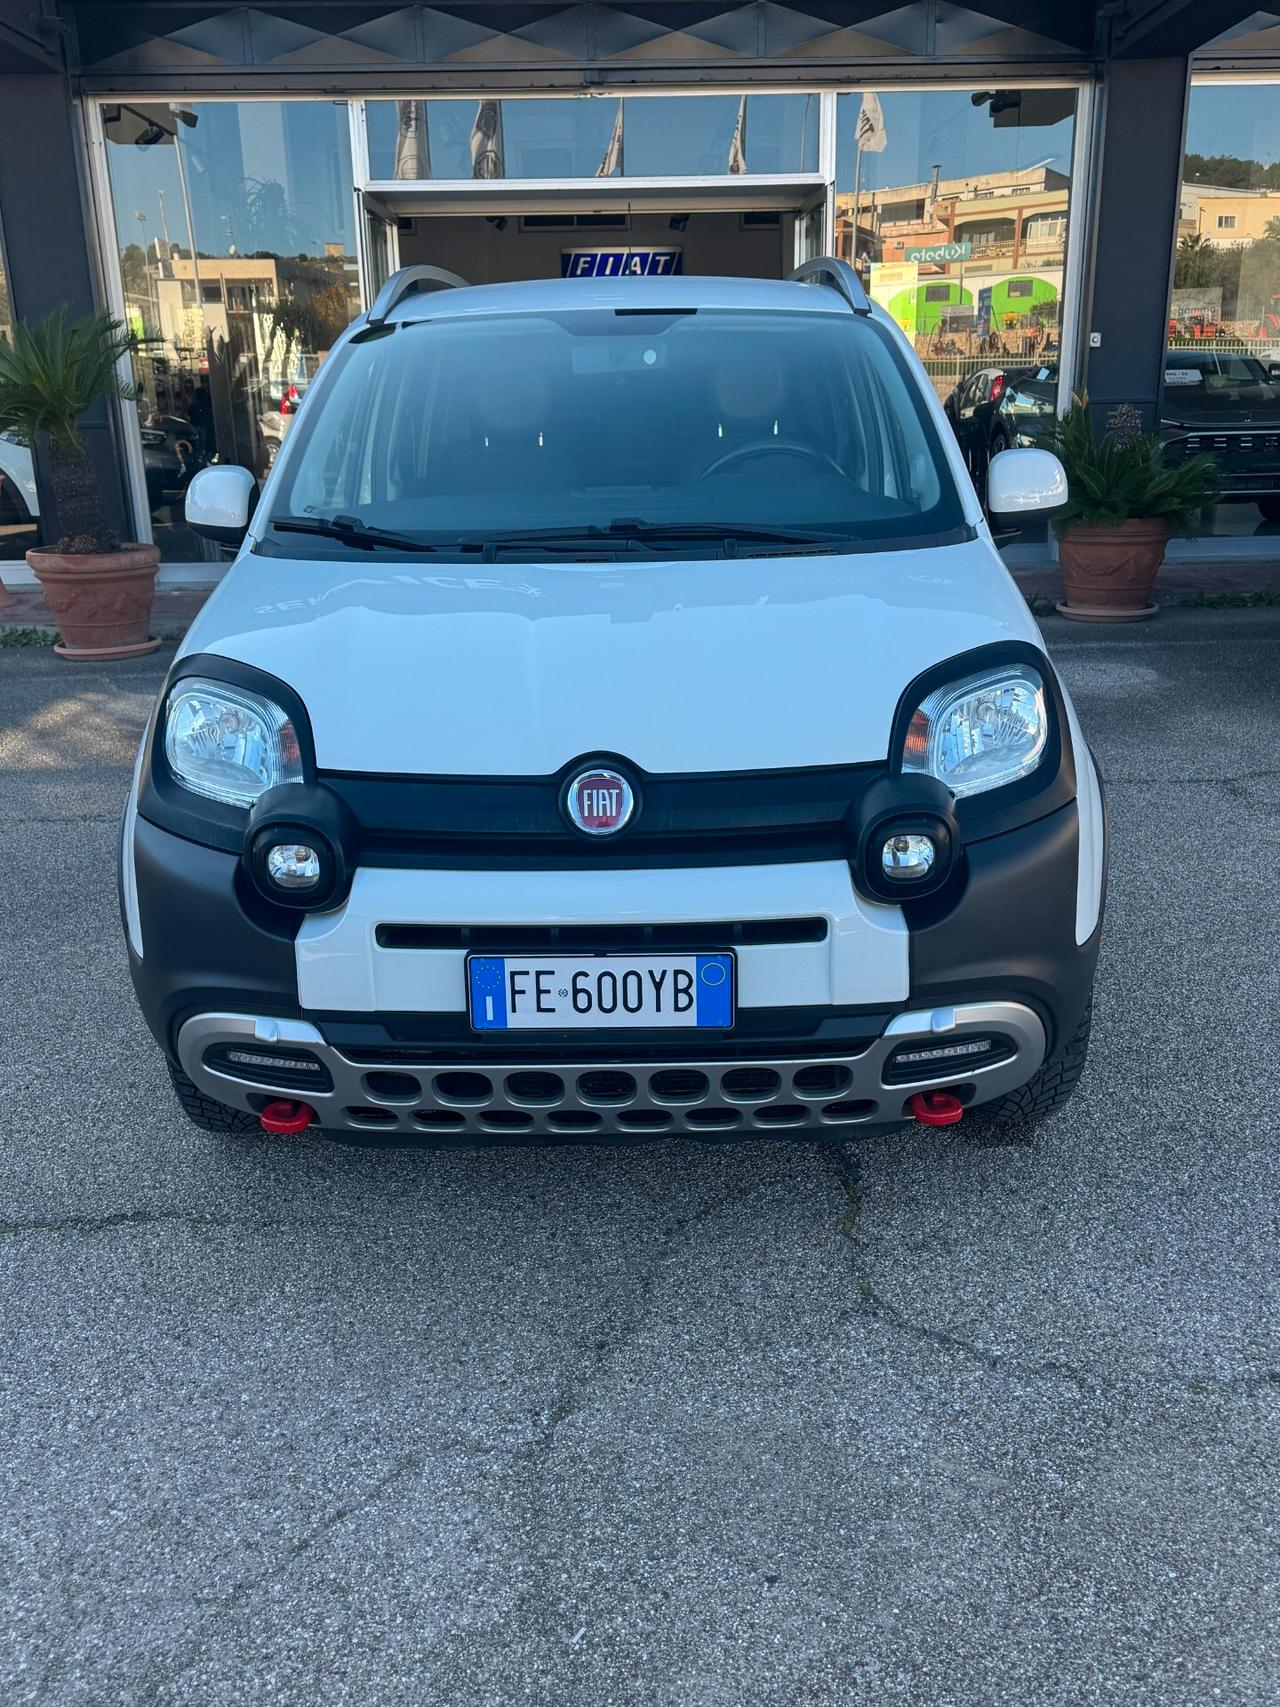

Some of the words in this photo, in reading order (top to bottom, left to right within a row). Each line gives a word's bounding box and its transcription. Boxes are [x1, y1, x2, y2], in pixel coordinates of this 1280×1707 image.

[575, 256, 671, 276] FIAT
[583, 789, 620, 817] FIAT
[509, 970, 556, 1013] FE
